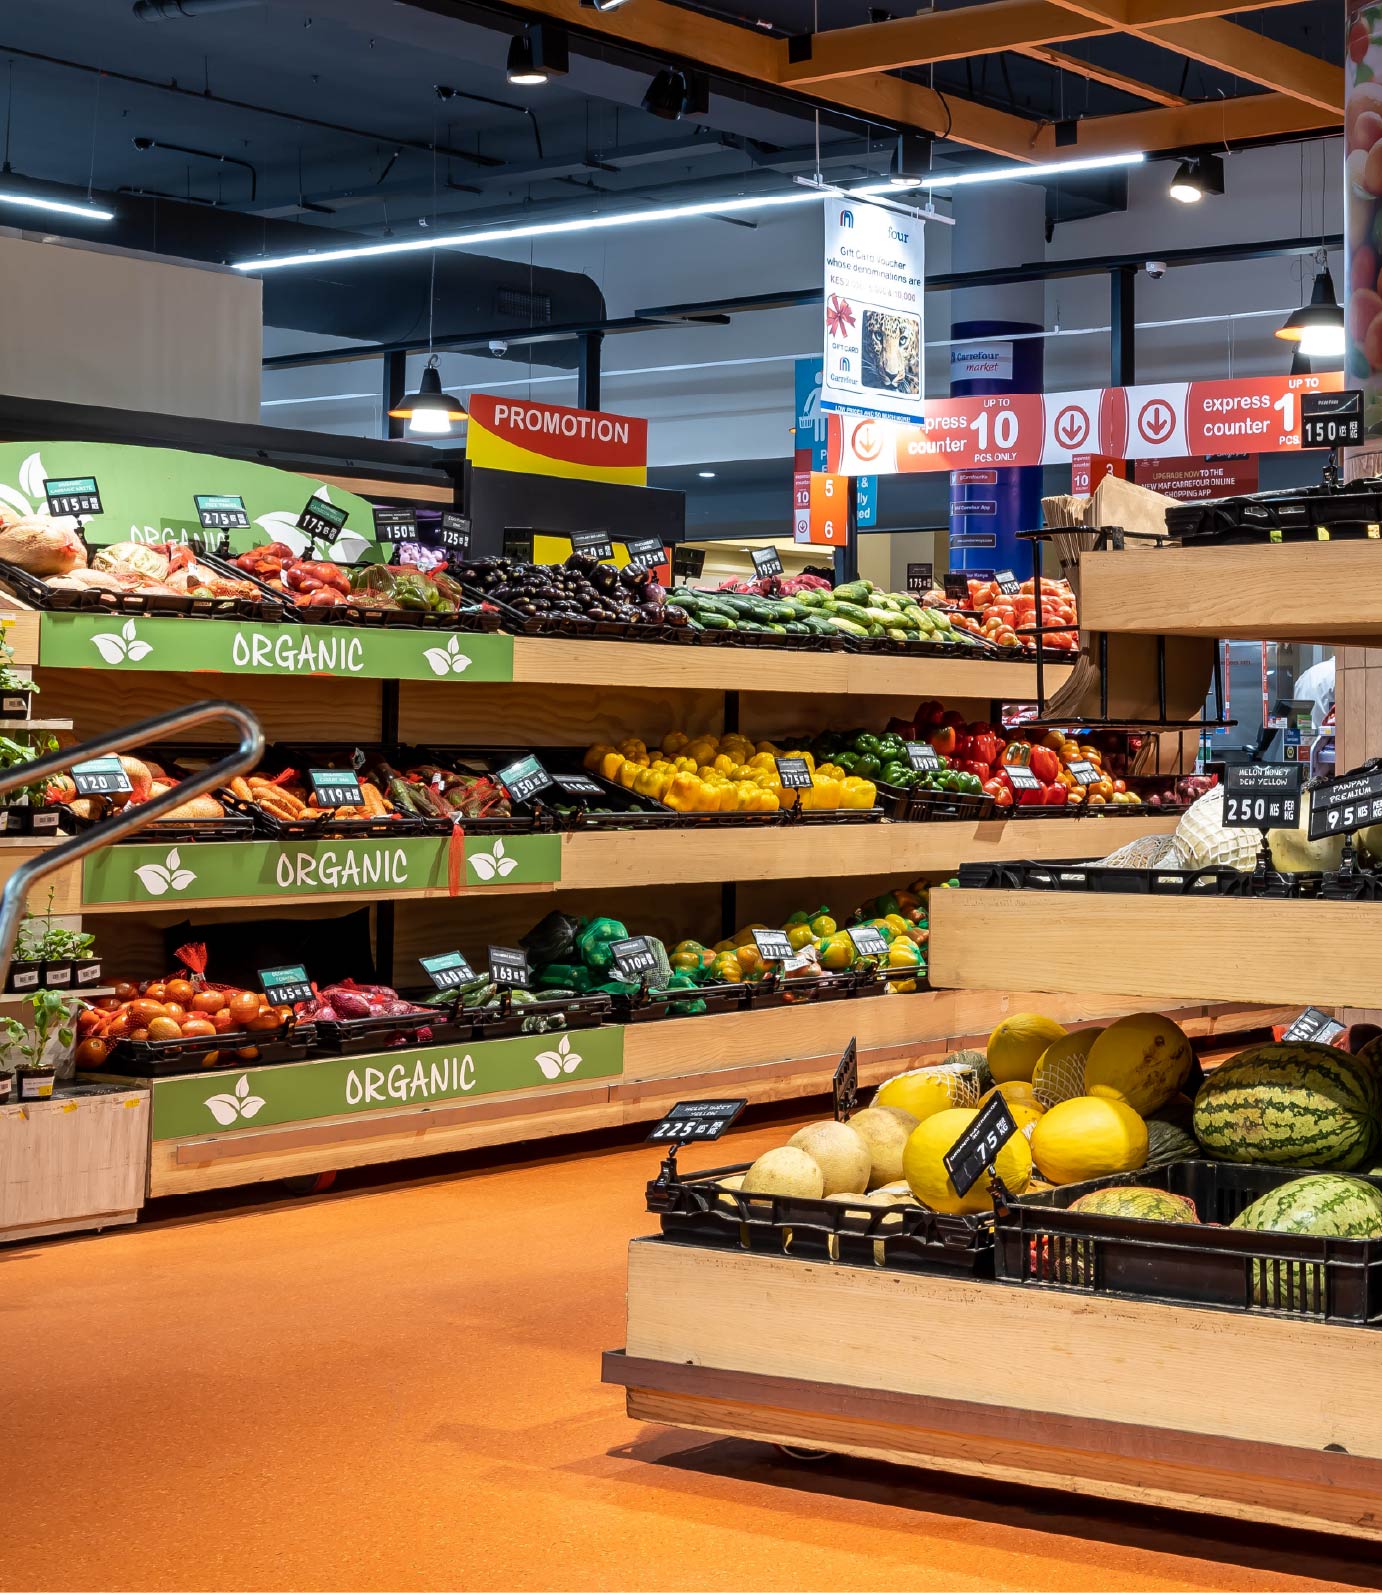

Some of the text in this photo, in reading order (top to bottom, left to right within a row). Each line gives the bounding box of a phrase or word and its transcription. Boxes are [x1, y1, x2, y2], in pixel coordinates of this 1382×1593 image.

[826, 257, 851, 270] whose
[908, 278, 921, 287] are
[956, 351, 999, 362] Carrefour
[966, 362, 998, 372] market
[1288, 377, 1319, 389] UP TO
[983, 398, 1010, 408] UP TO
[1203, 394, 1270, 414] express
[494, 404, 629, 444] PROMOTION
[970, 410, 1019, 450] 10
[1203, 417, 1270, 436] counter
[1305, 421, 1336, 442] 150
[908, 436, 967, 455] counter
[994, 452, 1017, 462] ONLY
[1074, 474, 1089, 487] 10
[1152, 468, 1224, 480] UPGRADE NOW TO THE
[825, 479, 834, 497] 5
[1157, 481, 1171, 490] MAF
[1171, 478, 1210, 489] CARREFOUR
[1210, 477, 1236, 486] ONLINE
[796, 491, 809, 503] 10
[1164, 488, 1212, 498] SHOPPING APP
[52, 498, 80, 513] 115
[203, 513, 229, 525] 275
[303, 514, 324, 533] 175
[386, 526, 408, 539] 150
[824, 520, 834, 538] 6
[443, 531, 458, 546] 125
[232, 631, 364, 673] ORGANIC
[1238, 767, 1291, 777] MELON HONEY
[78, 776, 108, 790] 120
[512, 780, 535, 798] 150
[1239, 777, 1288, 786] DEW YELLOW
[319, 788, 343, 803] 119
[1329, 786, 1372, 804] PREMIUM
[1227, 798, 1295, 821] 250 KES PER
[1328, 806, 1354, 830] 95
[1357, 805, 1368, 818] KES
[276, 848, 409, 889] ORGANIC
[493, 964, 512, 981] 163
[621, 957, 642, 973] 110
[435, 969, 459, 985] 160
[270, 988, 295, 1003] 165
[345, 1054, 477, 1105] ORGANIC
[653, 1121, 696, 1138] 225
[976, 1130, 998, 1163] 75
